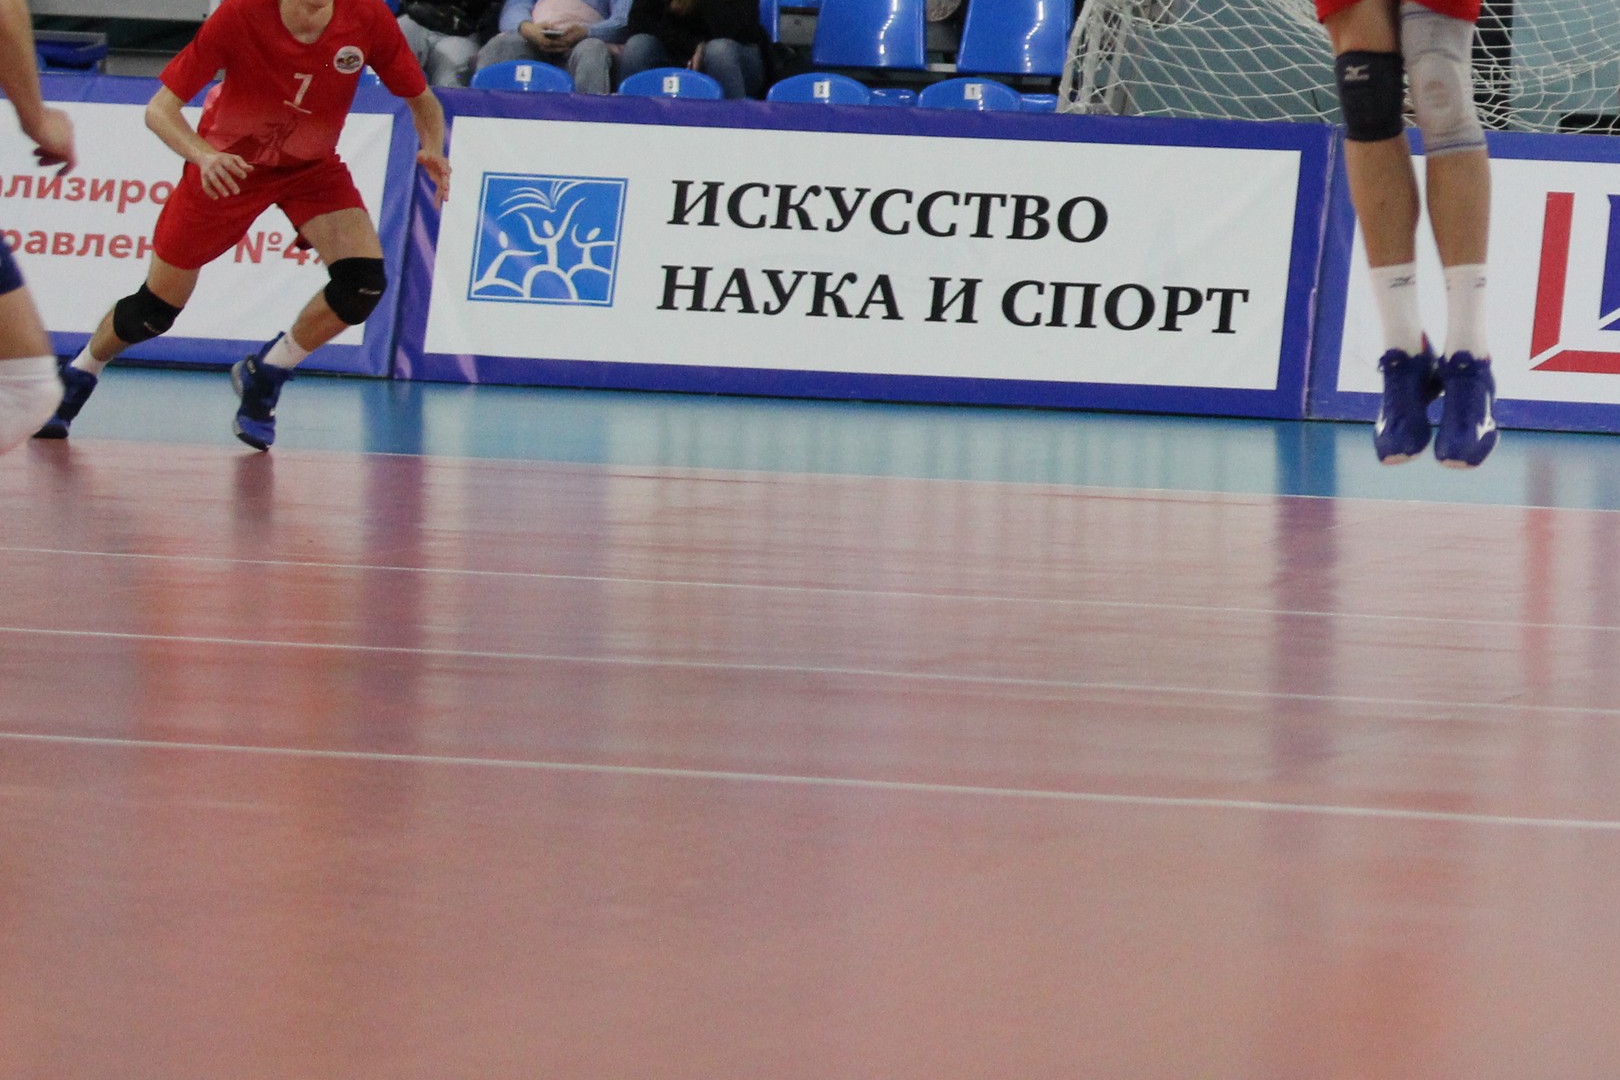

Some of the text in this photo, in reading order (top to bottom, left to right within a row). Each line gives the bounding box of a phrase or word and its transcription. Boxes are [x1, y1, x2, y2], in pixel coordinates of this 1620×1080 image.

[293, 73, 314, 107] 7
[666, 180, 1108, 244] ИСКУССТВО
[656, 265, 1250, 334] НАУКА И СПОРТ
